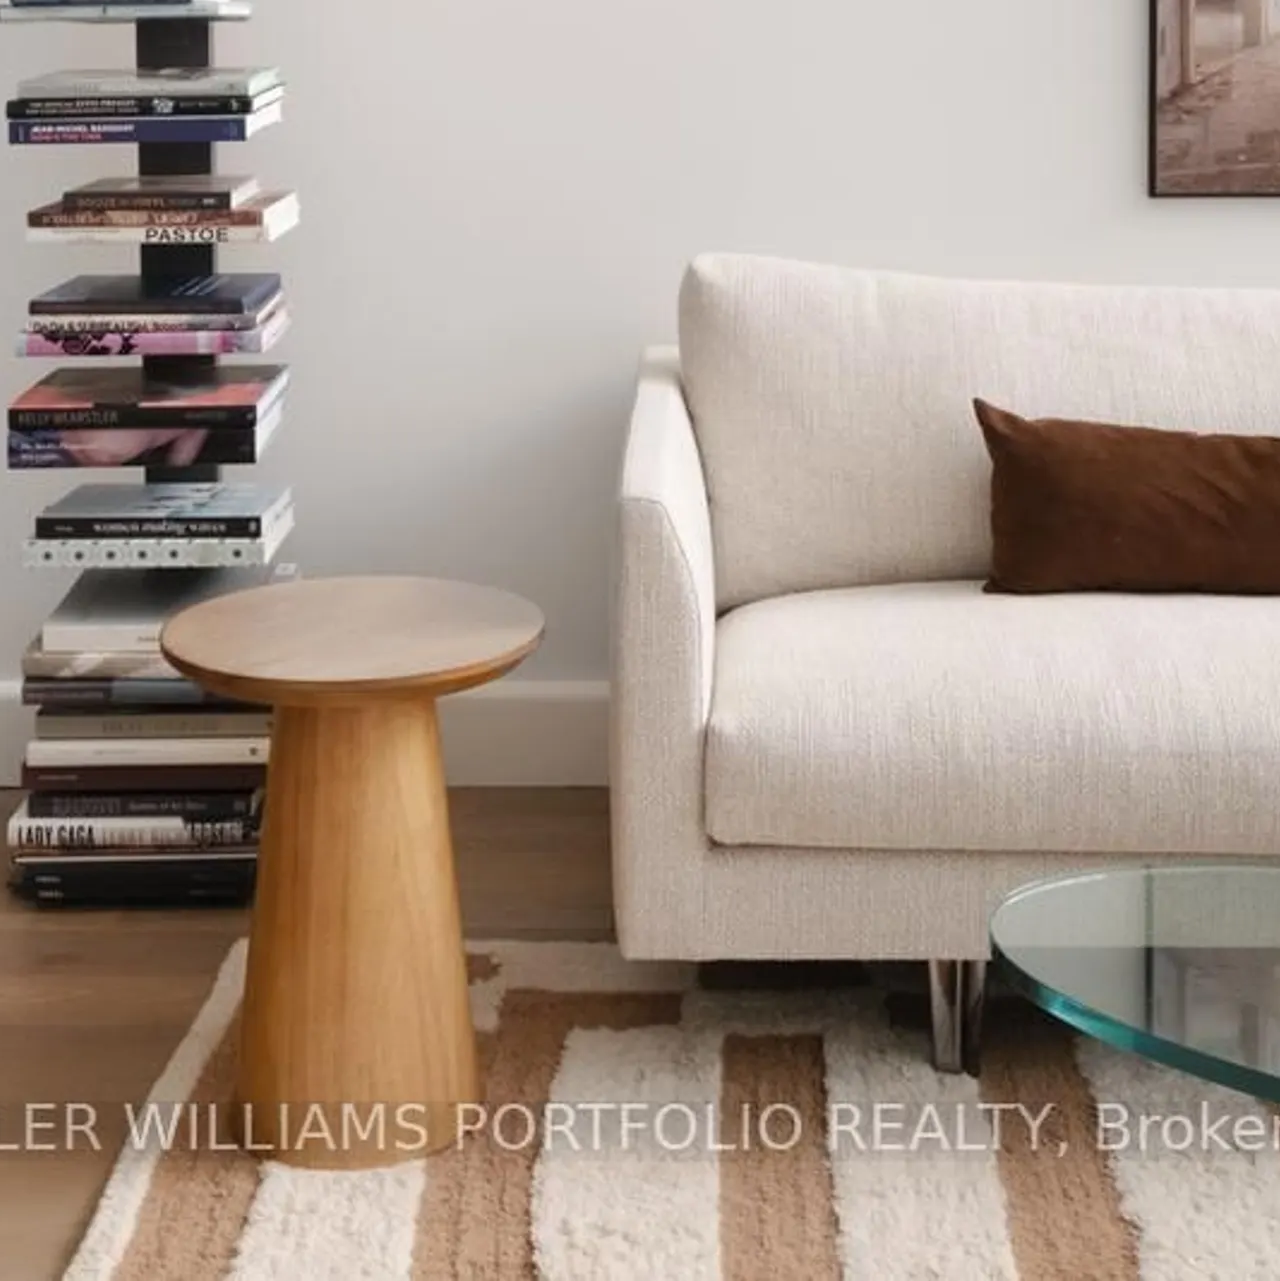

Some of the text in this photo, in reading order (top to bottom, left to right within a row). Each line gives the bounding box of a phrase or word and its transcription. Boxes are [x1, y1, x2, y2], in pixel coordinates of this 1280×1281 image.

[145, 227, 229, 243] PASTOE
[18, 824, 53, 846] LADY
[57, 824, 96, 847] GAGA
